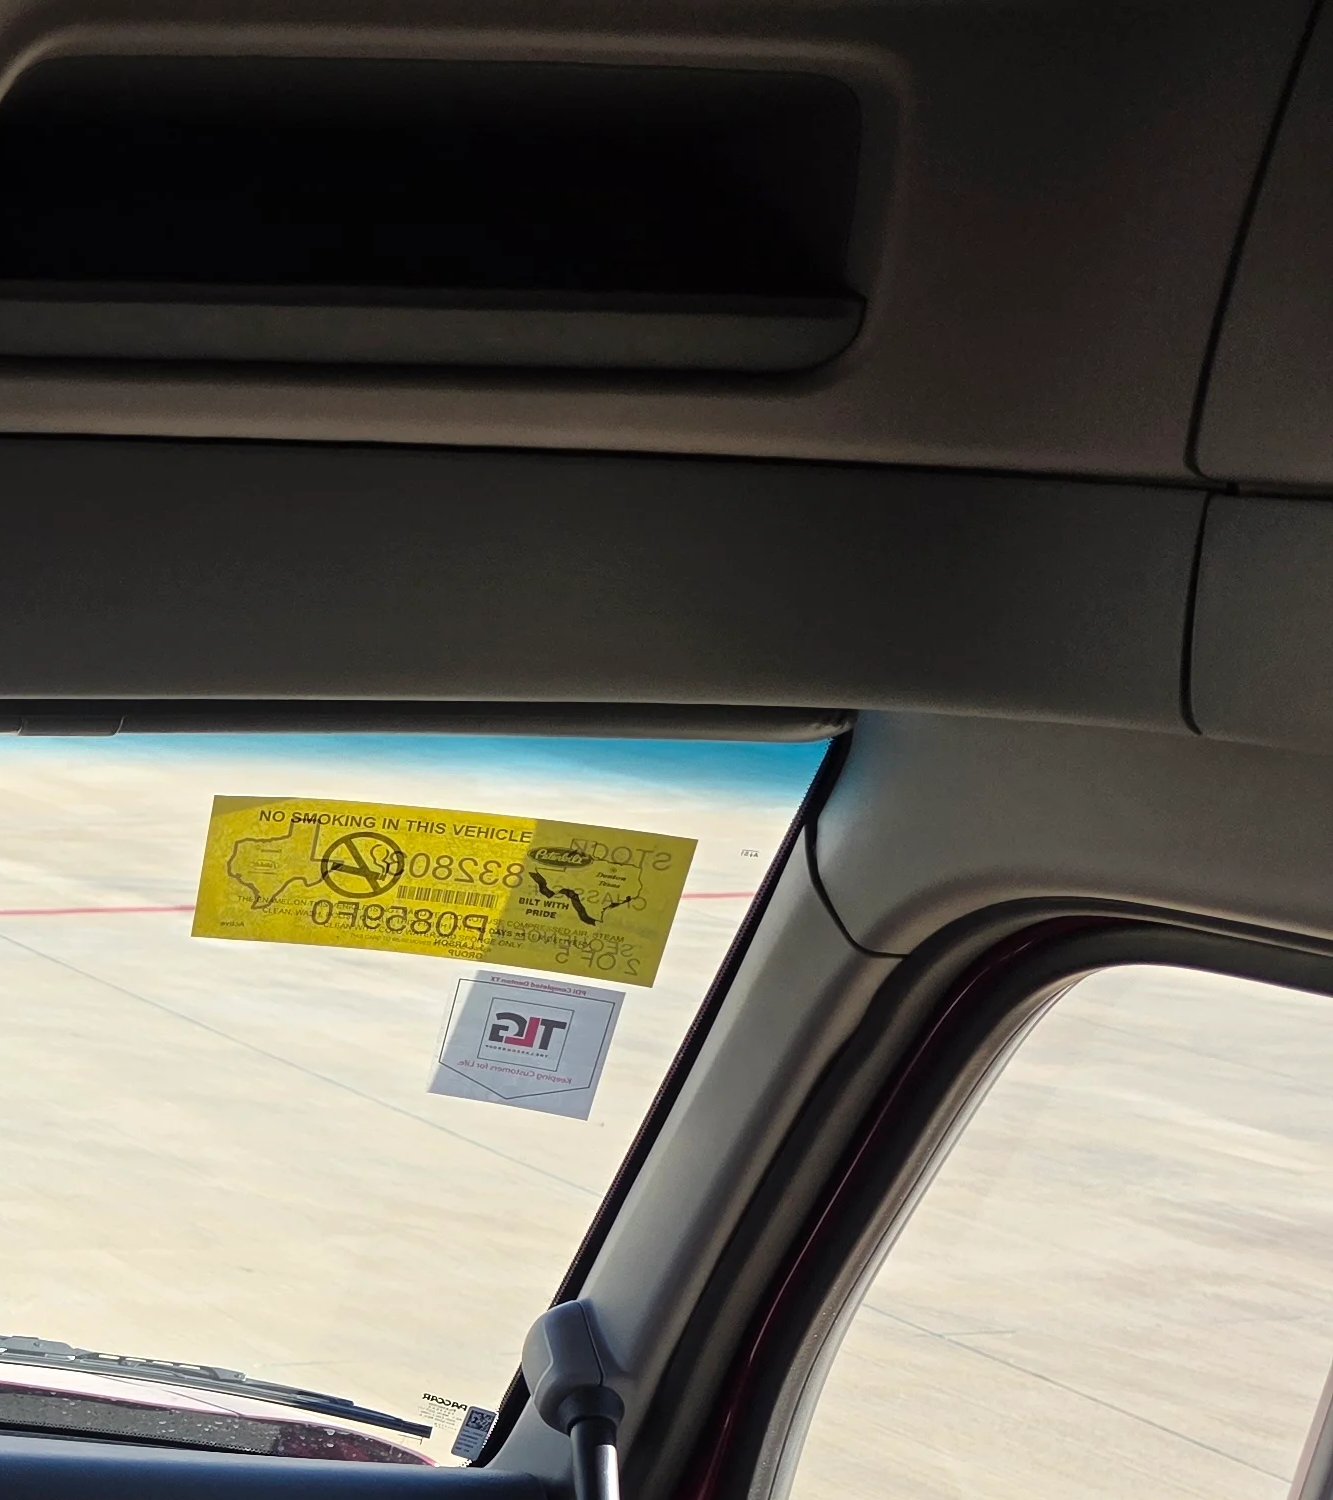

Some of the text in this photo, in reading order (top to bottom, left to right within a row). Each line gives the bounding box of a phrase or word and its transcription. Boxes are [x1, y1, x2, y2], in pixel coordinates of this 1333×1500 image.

[259, 809, 533, 843] NO SMOKING IN THIS VEHICLE
[519, 897, 569, 910] BILT WITH
[525, 908, 558, 919] PRIDE
